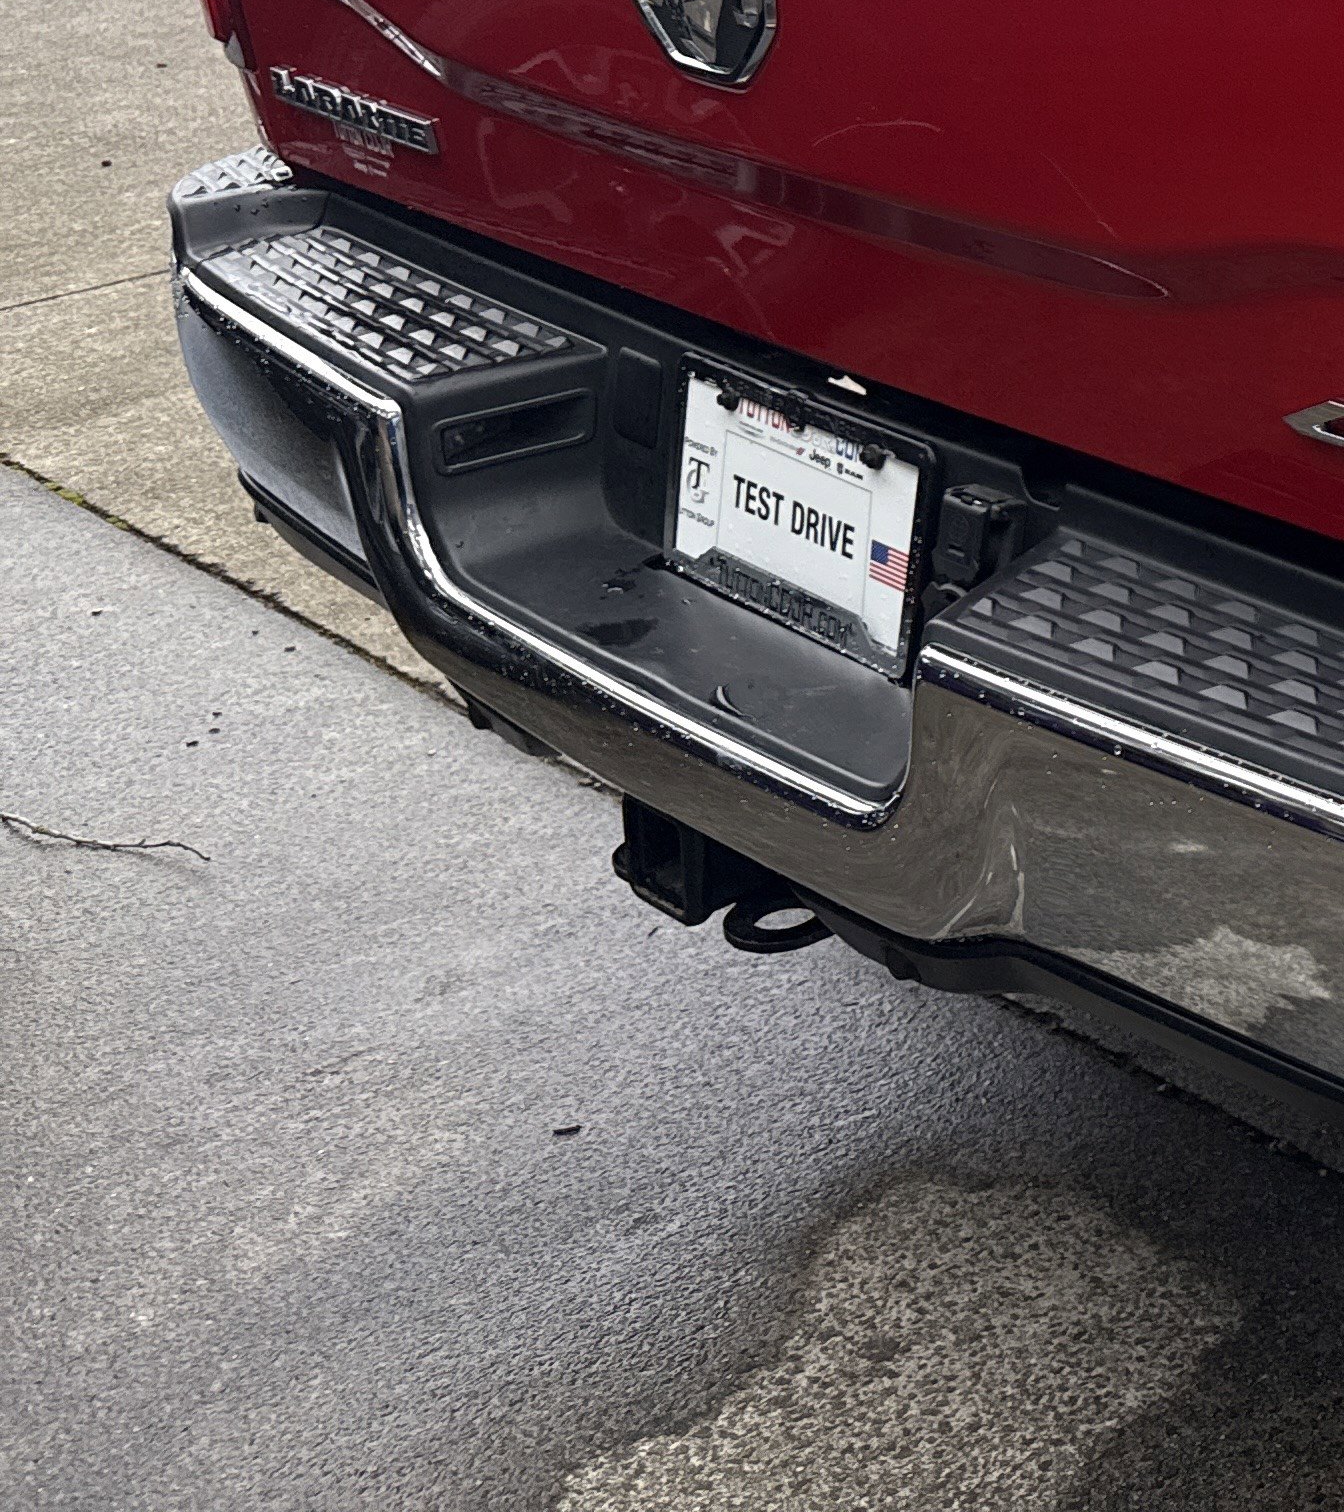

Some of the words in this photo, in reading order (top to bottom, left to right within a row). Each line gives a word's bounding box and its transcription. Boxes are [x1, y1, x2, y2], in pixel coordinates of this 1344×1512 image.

[808, 448, 831, 470] Jeep
[733, 474, 784, 526] TEST
[791, 500, 856, 560] DRIVE
